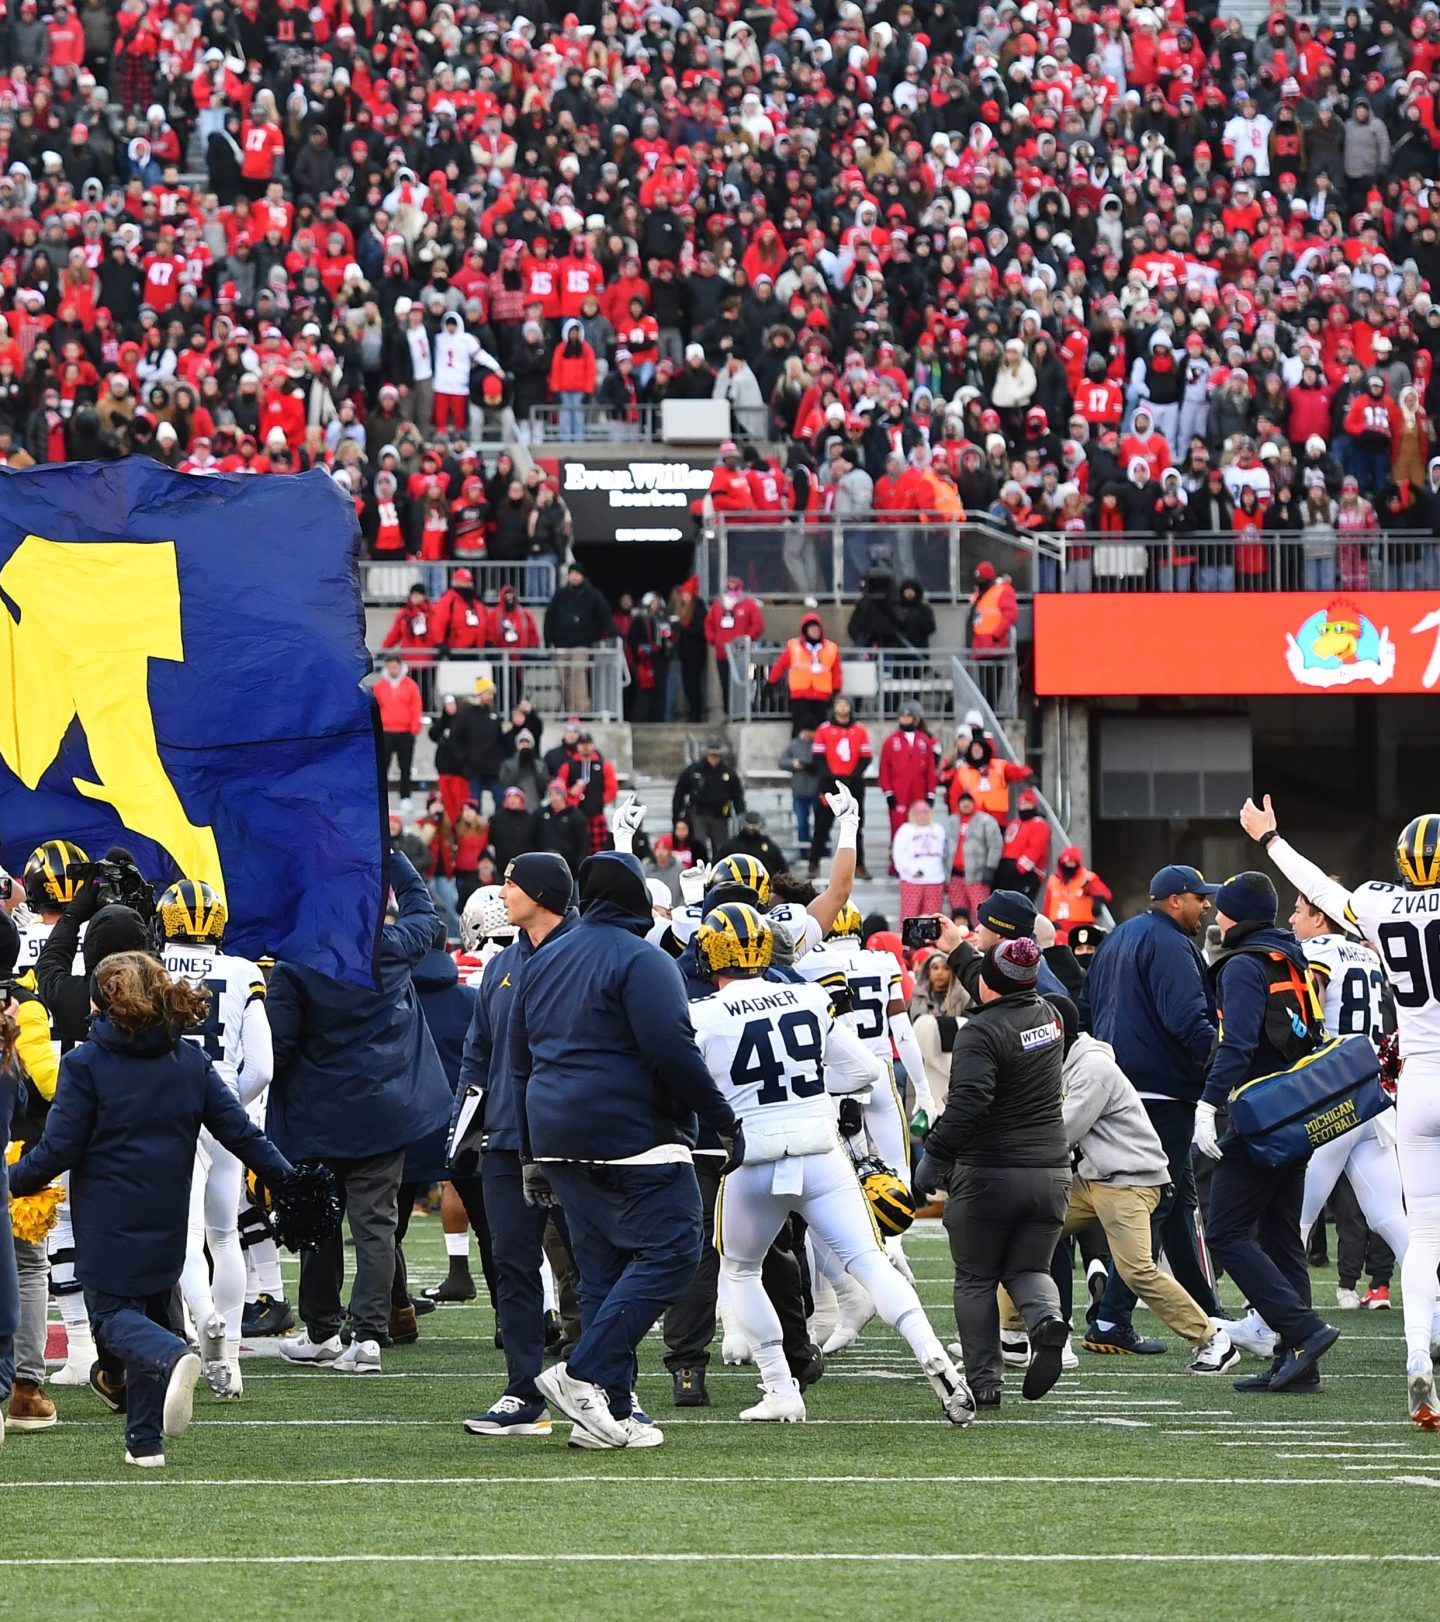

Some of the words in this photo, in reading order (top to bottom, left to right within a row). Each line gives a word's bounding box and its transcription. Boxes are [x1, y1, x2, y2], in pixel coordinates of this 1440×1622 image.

[147, 261, 173, 286] 47
[529, 271, 553, 296] 15
[566, 270, 590, 294] 15
[1088, 389, 1110, 413] 17
[564, 463, 634, 490] Evan
[835, 736, 851, 763] 4
[723, 990, 799, 1017] WAGNER
[1023, 1026, 1049, 1042] WTOL
[730, 1009, 825, 1105] 49
[1304, 1099, 1355, 1134] MICHIGAN
[1309, 1112, 1361, 1147] FOOTBALL
